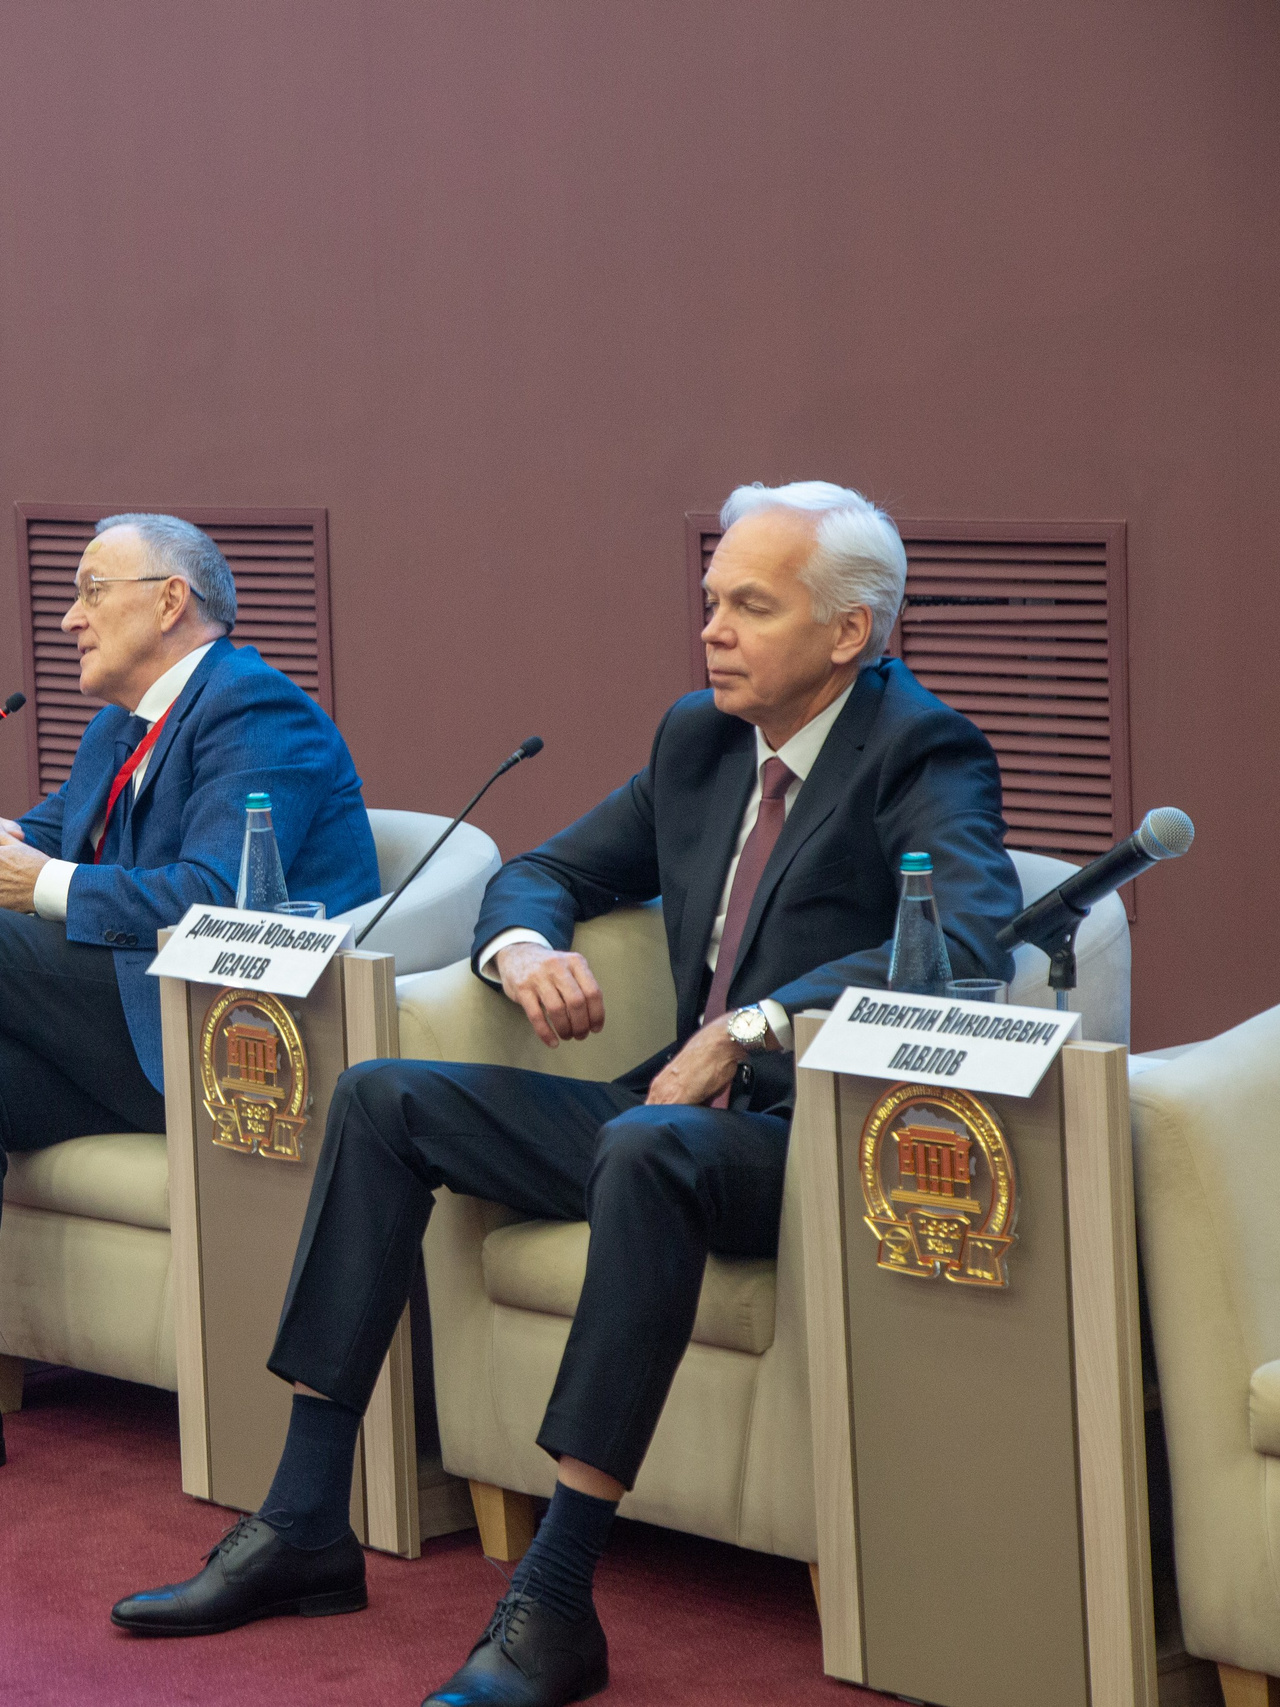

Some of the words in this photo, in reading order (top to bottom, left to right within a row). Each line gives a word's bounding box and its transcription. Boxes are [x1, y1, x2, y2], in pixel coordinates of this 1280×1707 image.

[185, 914, 265, 944] Дмитрий
[260, 922, 337, 954] Юрьевич
[209, 951, 272, 980] УСАЧЕВ
[847, 996, 944, 1032] Валентин
[936, 1006, 1060, 1046] Николаевич
[887, 1043, 968, 1076] ПАВЛОВ
